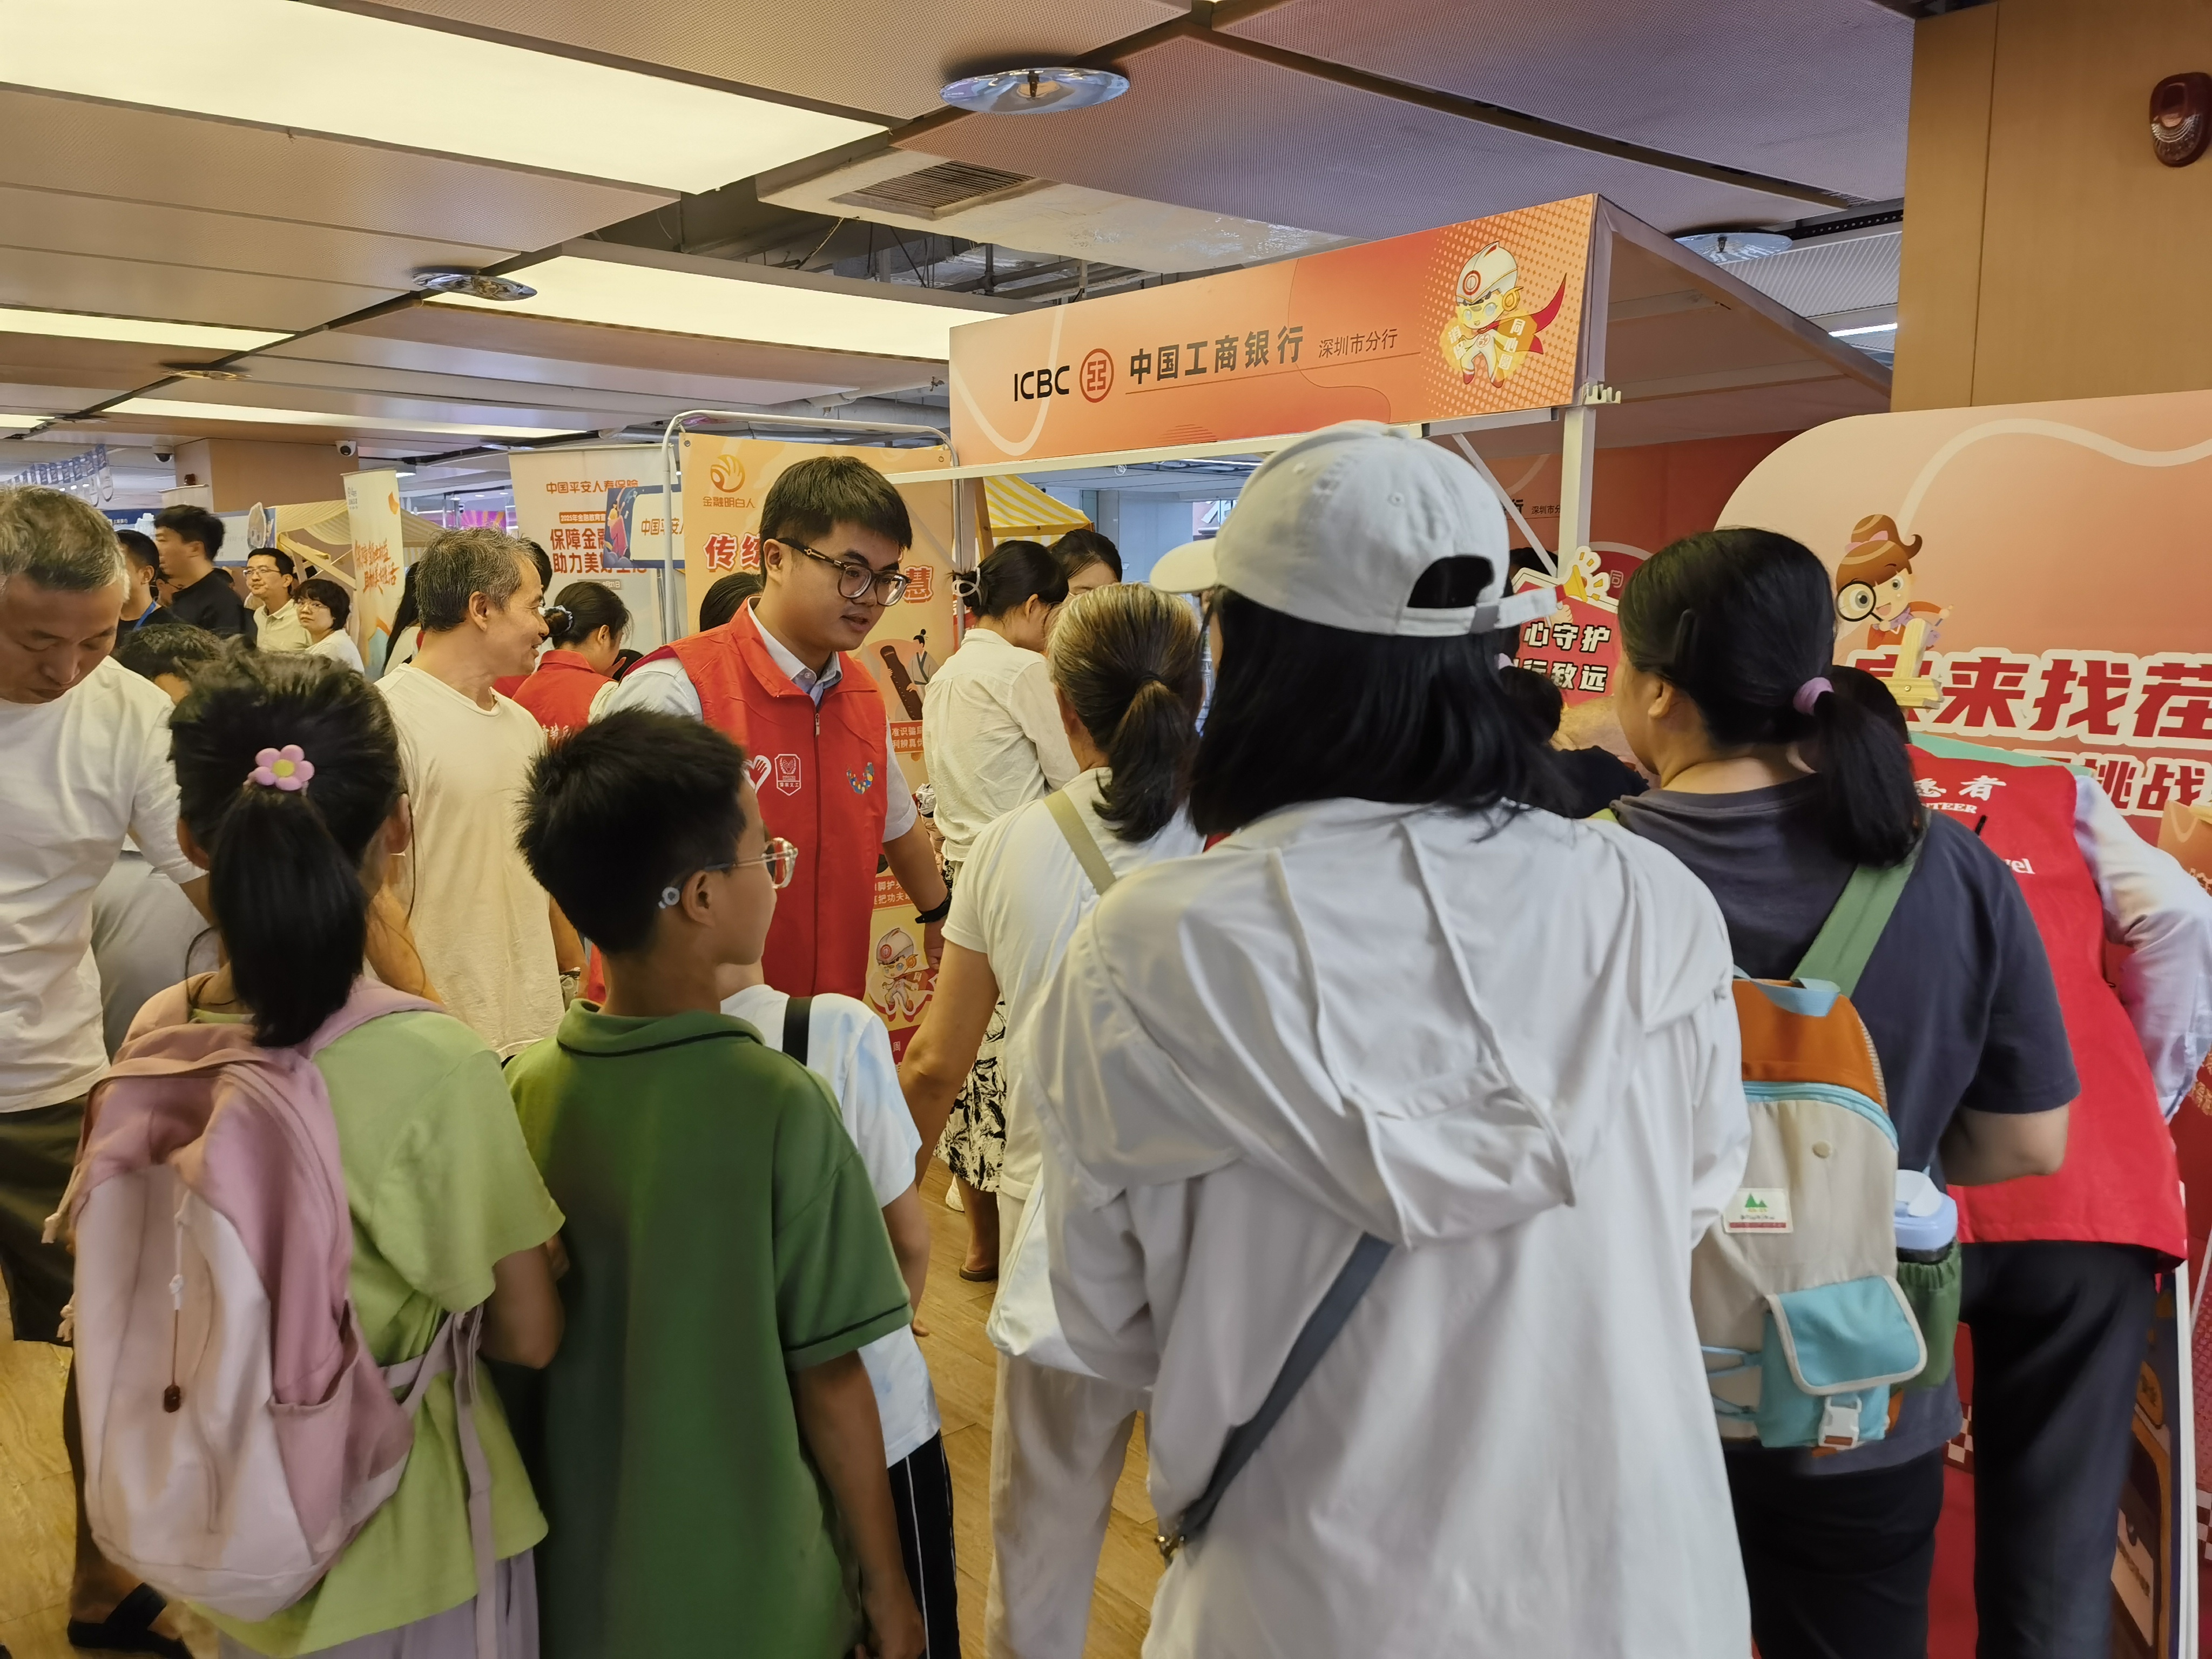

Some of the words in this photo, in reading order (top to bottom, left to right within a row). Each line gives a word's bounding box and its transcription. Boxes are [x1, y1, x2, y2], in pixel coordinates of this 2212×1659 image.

[1130, 325, 1304, 385] 中国工商银行
[1318, 328, 1398, 359] 深圳市分行
[1014, 365, 1070, 402] ICBC
[703, 496, 756, 508] 金融明白人
[1523, 621, 1611, 653] 心守护
[2040, 757, 2206, 810] 挑战
